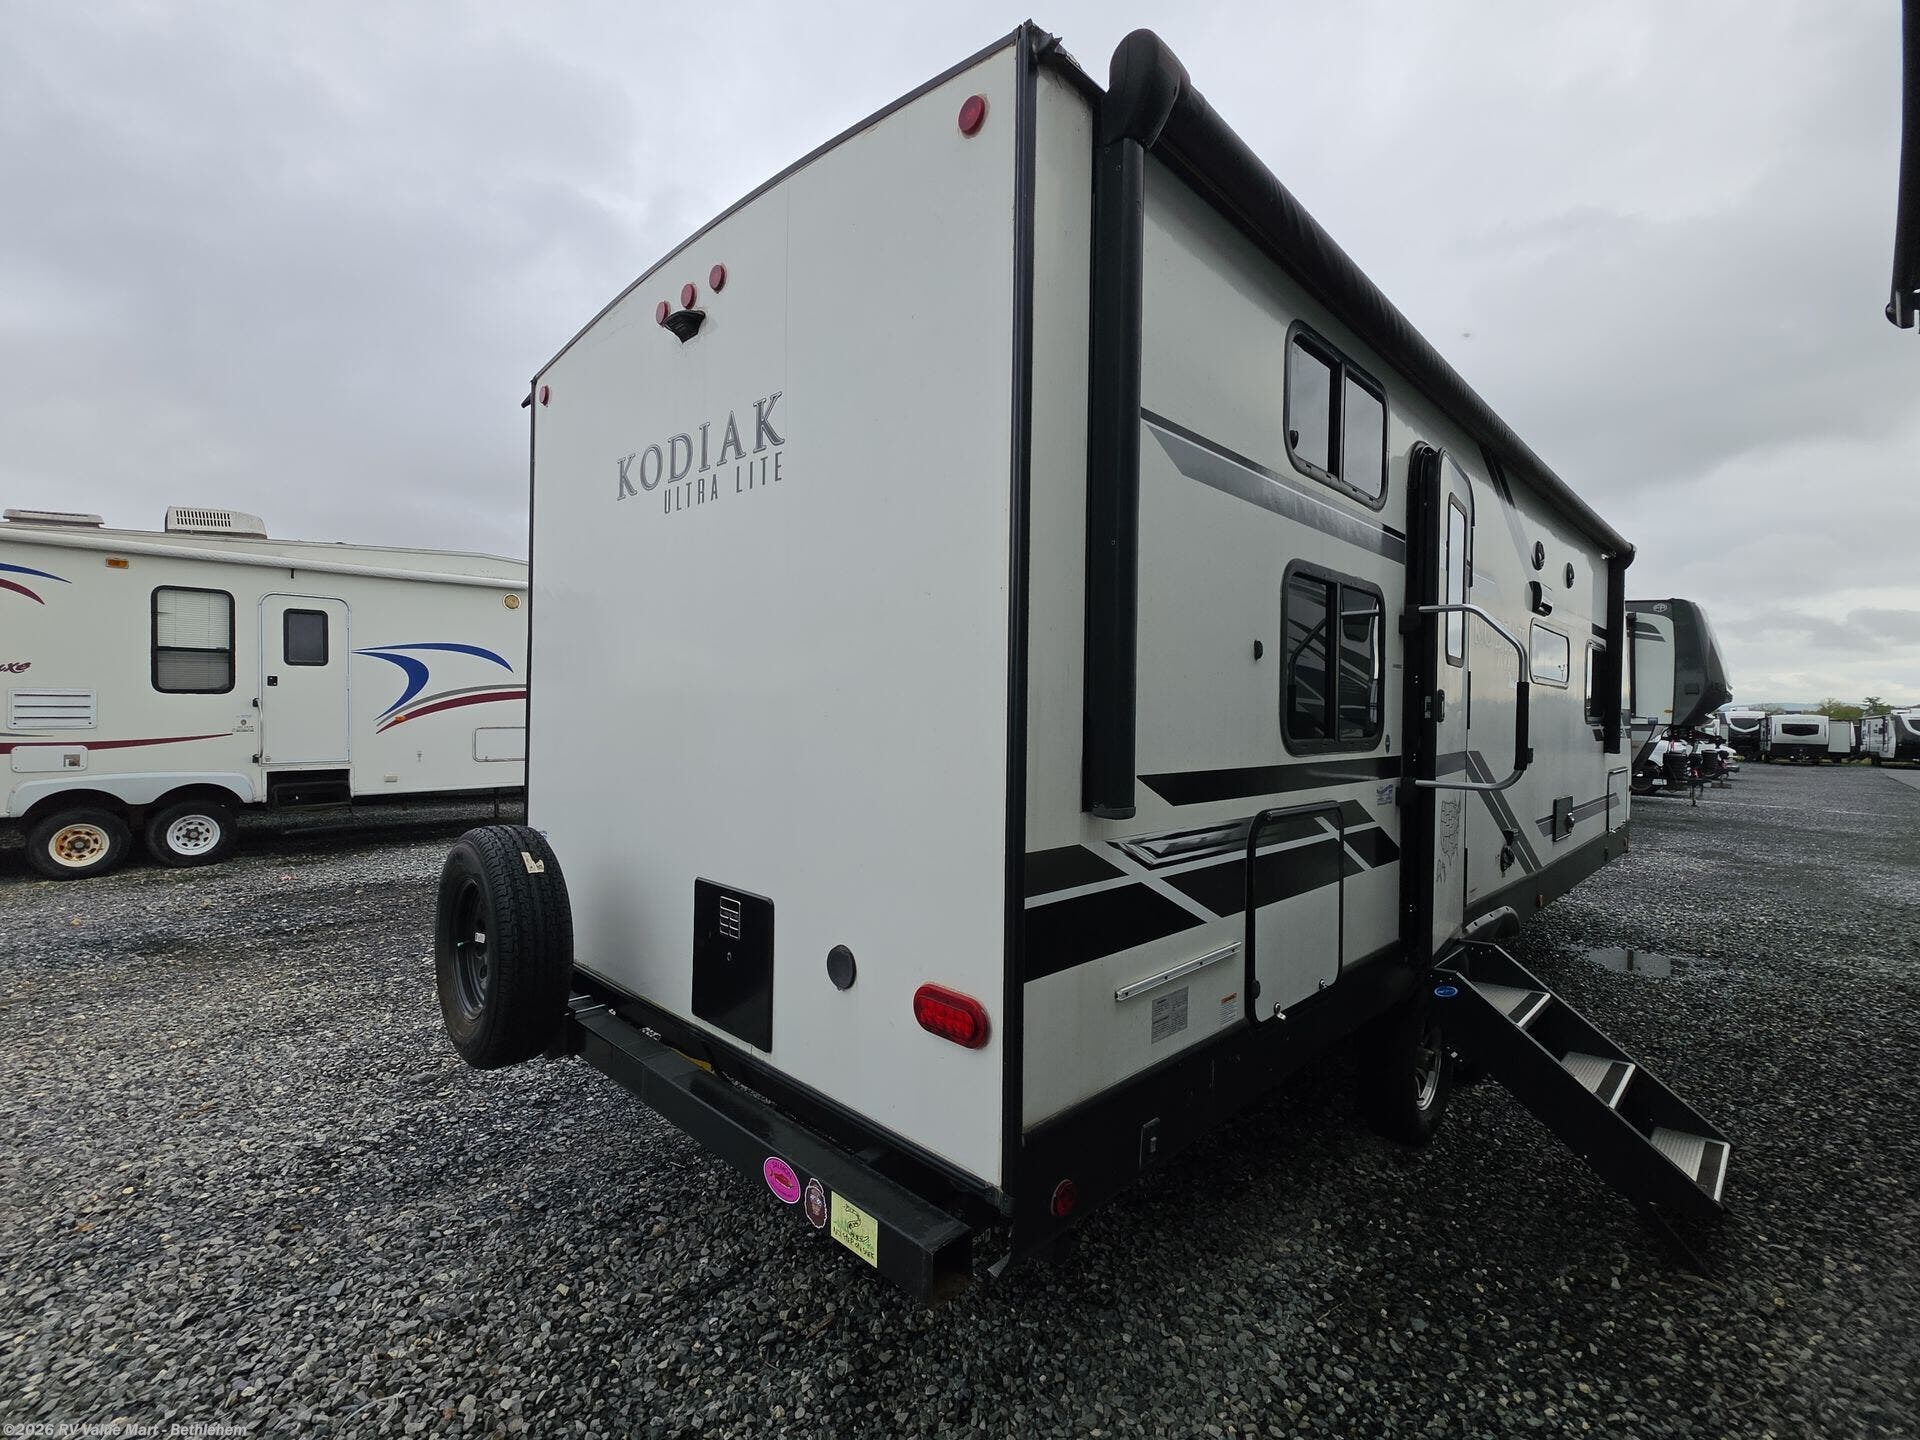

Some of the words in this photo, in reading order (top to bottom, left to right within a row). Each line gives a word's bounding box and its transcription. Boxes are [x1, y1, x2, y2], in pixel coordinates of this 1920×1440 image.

[616, 390, 785, 501] KODIAK
[664, 473, 718, 514] ULTRA
[736, 451, 783, 493] LITE
